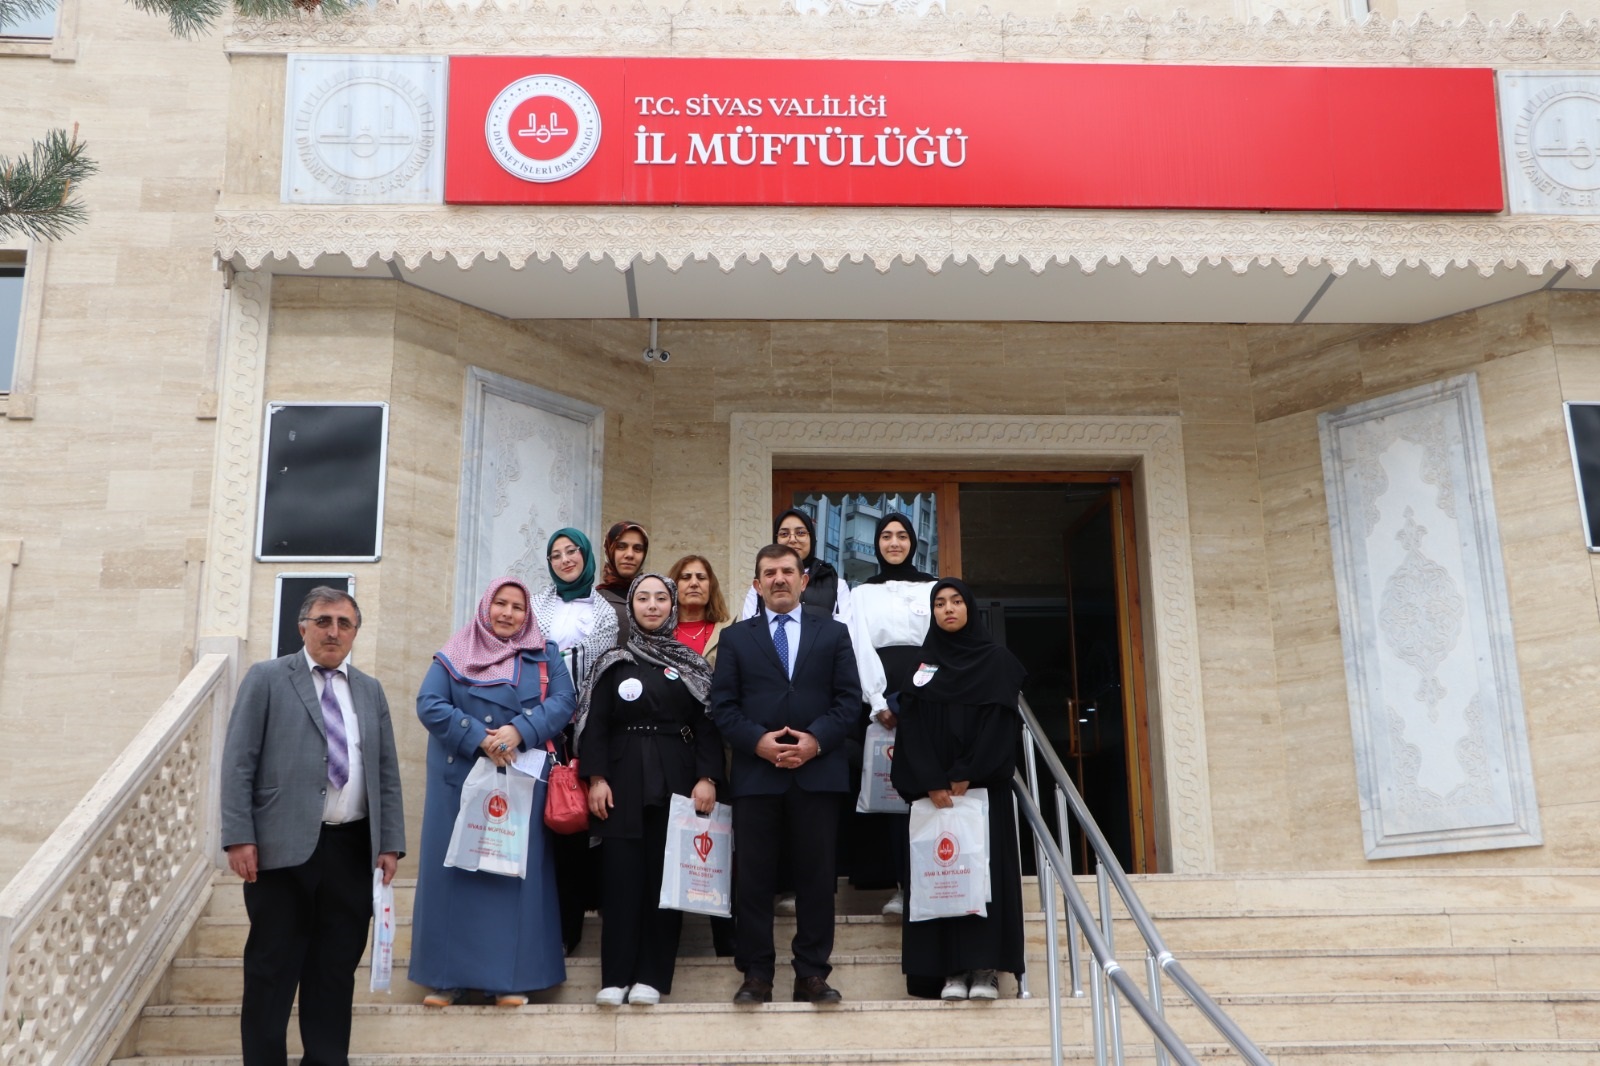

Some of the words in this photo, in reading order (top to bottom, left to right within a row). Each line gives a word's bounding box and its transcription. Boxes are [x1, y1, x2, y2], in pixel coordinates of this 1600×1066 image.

[634, 96, 680, 116] T.C.
[686, 93, 762, 117] SİVAS
[768, 94, 887, 118] VALİLİĞİ
[493, 130, 520, 167] DİYANET
[520, 162, 553, 175] İŞLERİ
[554, 127, 594, 173] BAŞKANLIĞI
[633, 125, 677, 165] İL
[685, 125, 968, 168] MÜFTÜLÜĞÜ
